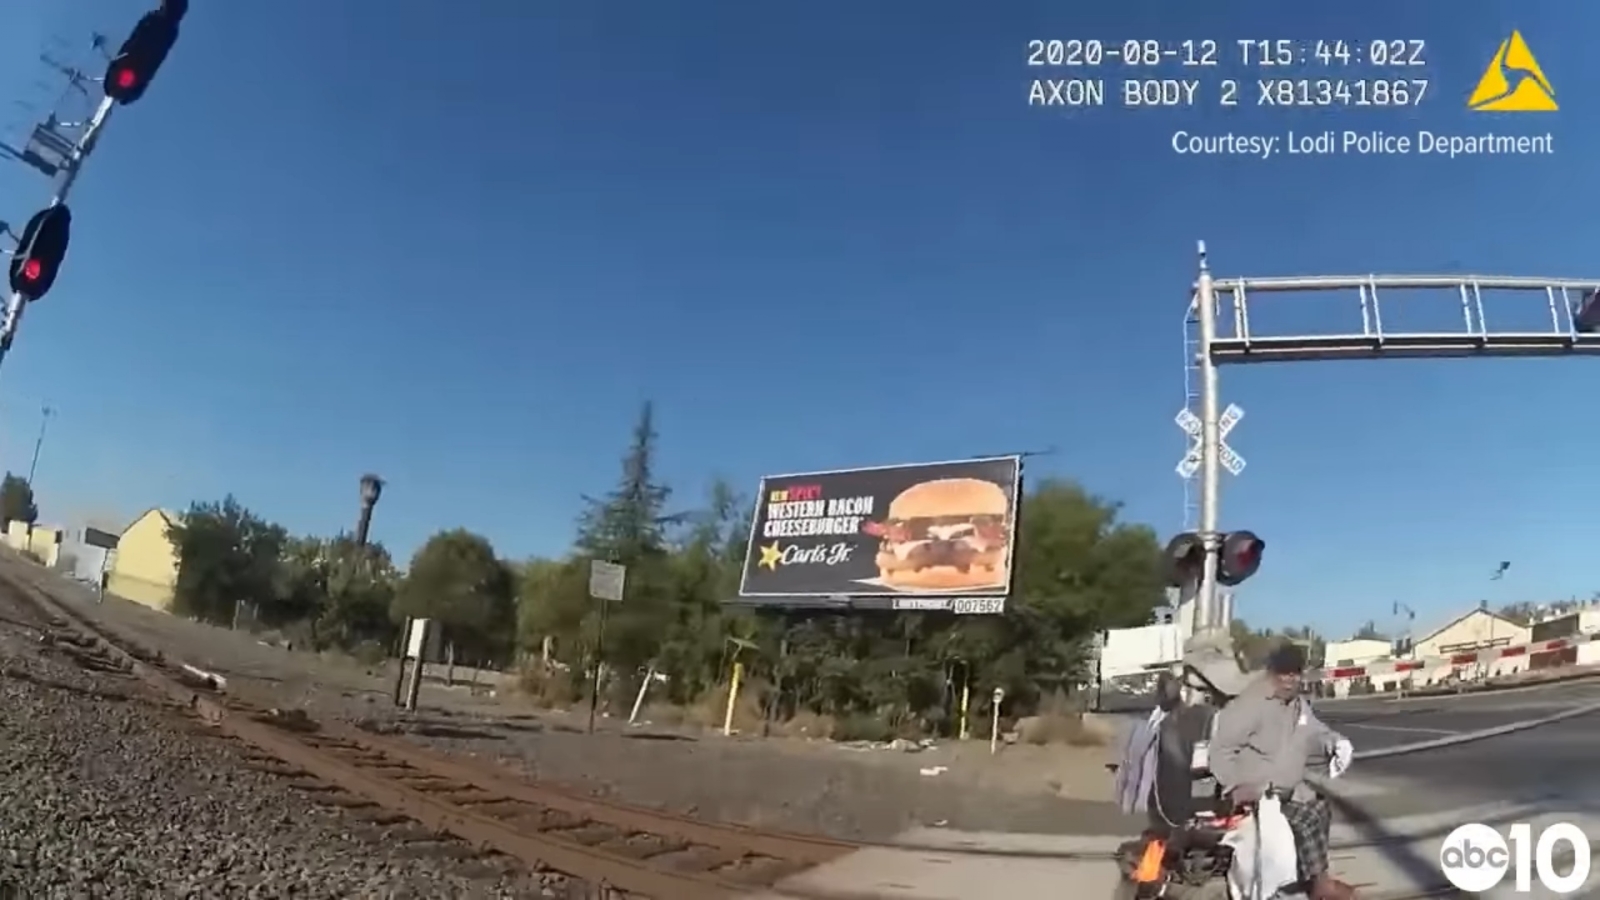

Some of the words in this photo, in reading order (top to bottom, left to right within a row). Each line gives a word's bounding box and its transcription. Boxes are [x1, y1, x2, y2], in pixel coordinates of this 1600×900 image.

[767, 500, 825, 520] WESTERN
[827, 496, 874, 516] BACON
[763, 516, 860, 538] CHEESEBURGER
[780, 544, 826, 565] Carl's
